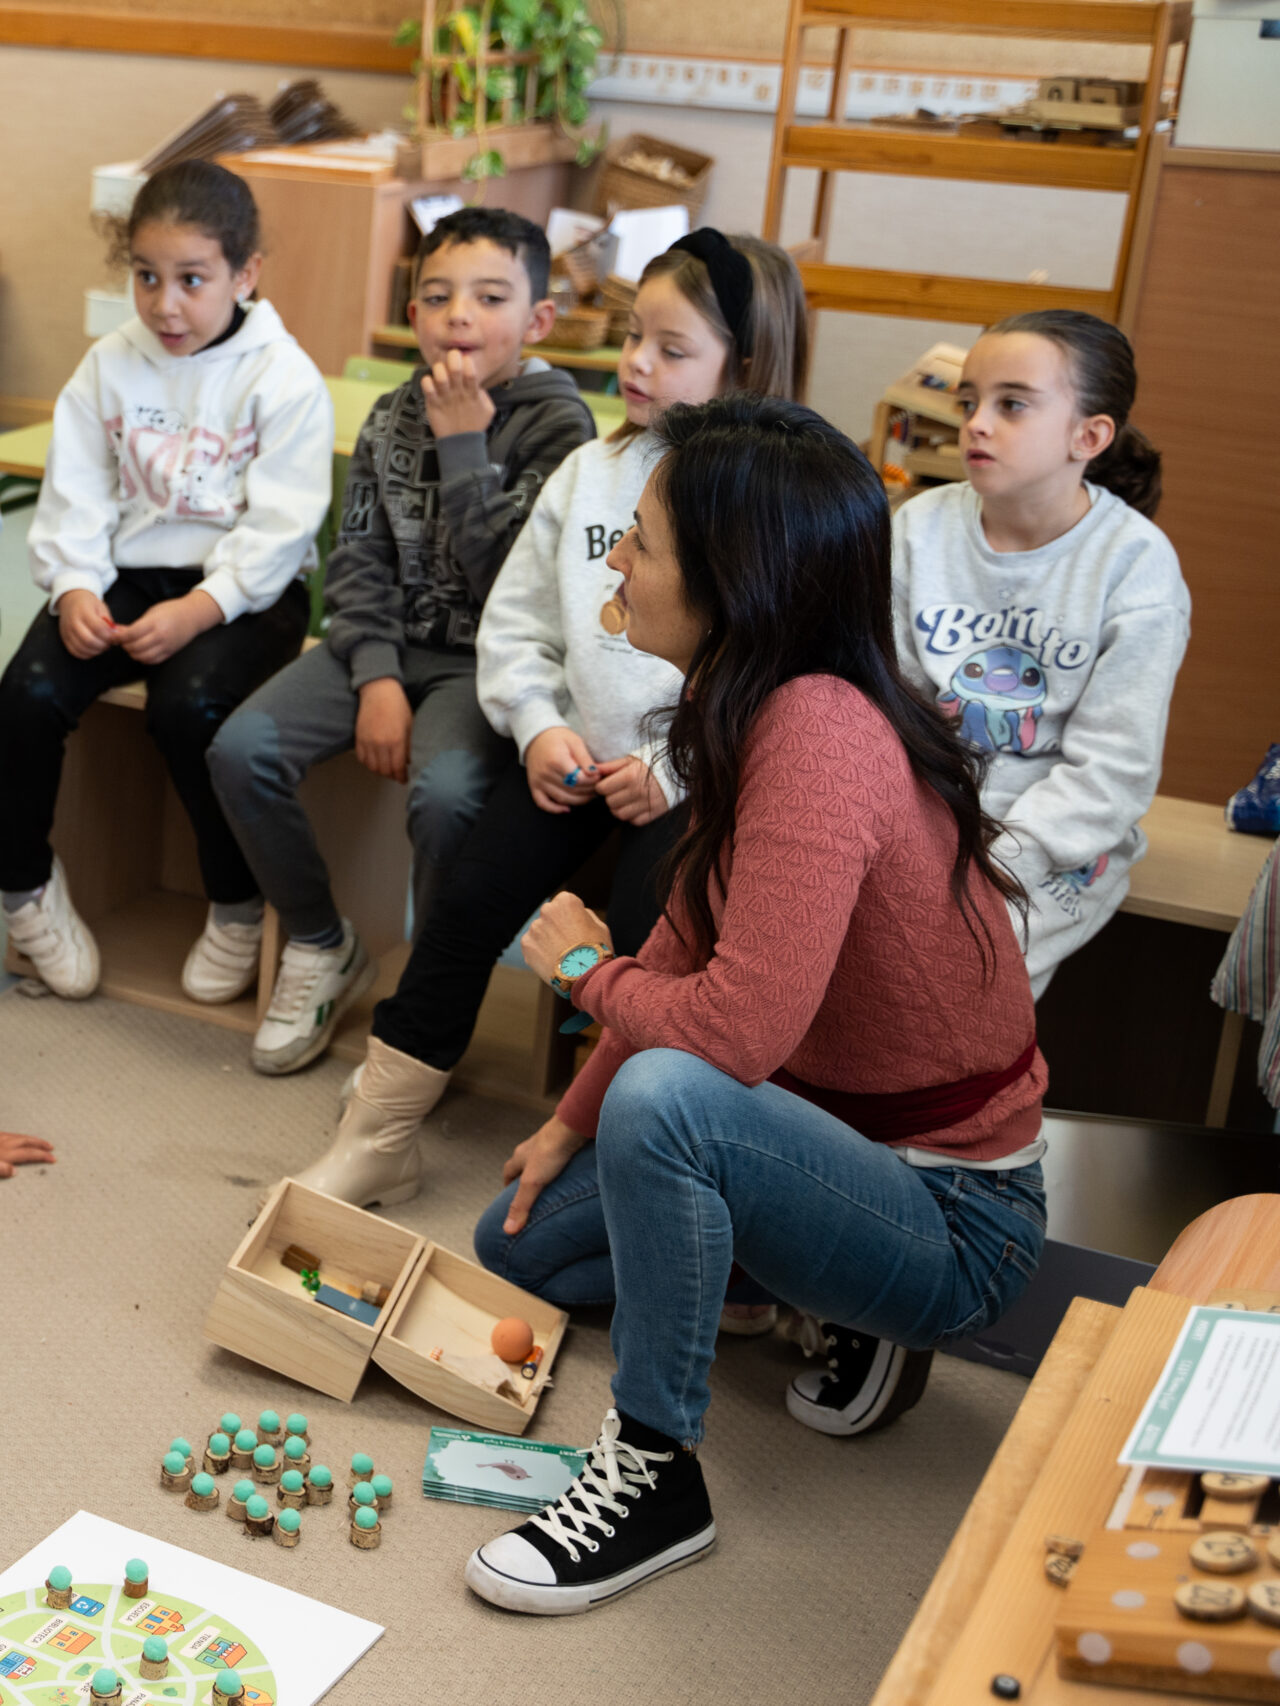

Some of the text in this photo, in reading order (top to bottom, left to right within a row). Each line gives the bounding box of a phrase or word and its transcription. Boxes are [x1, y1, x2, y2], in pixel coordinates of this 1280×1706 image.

[585, 524, 632, 560] Be
[915, 603, 1091, 670] Born to
[126, 1602, 151, 1622] ESCUELA
[32, 1618, 64, 1644] BIBLIOTECA
[190, 1633, 212, 1651] TIENDA
